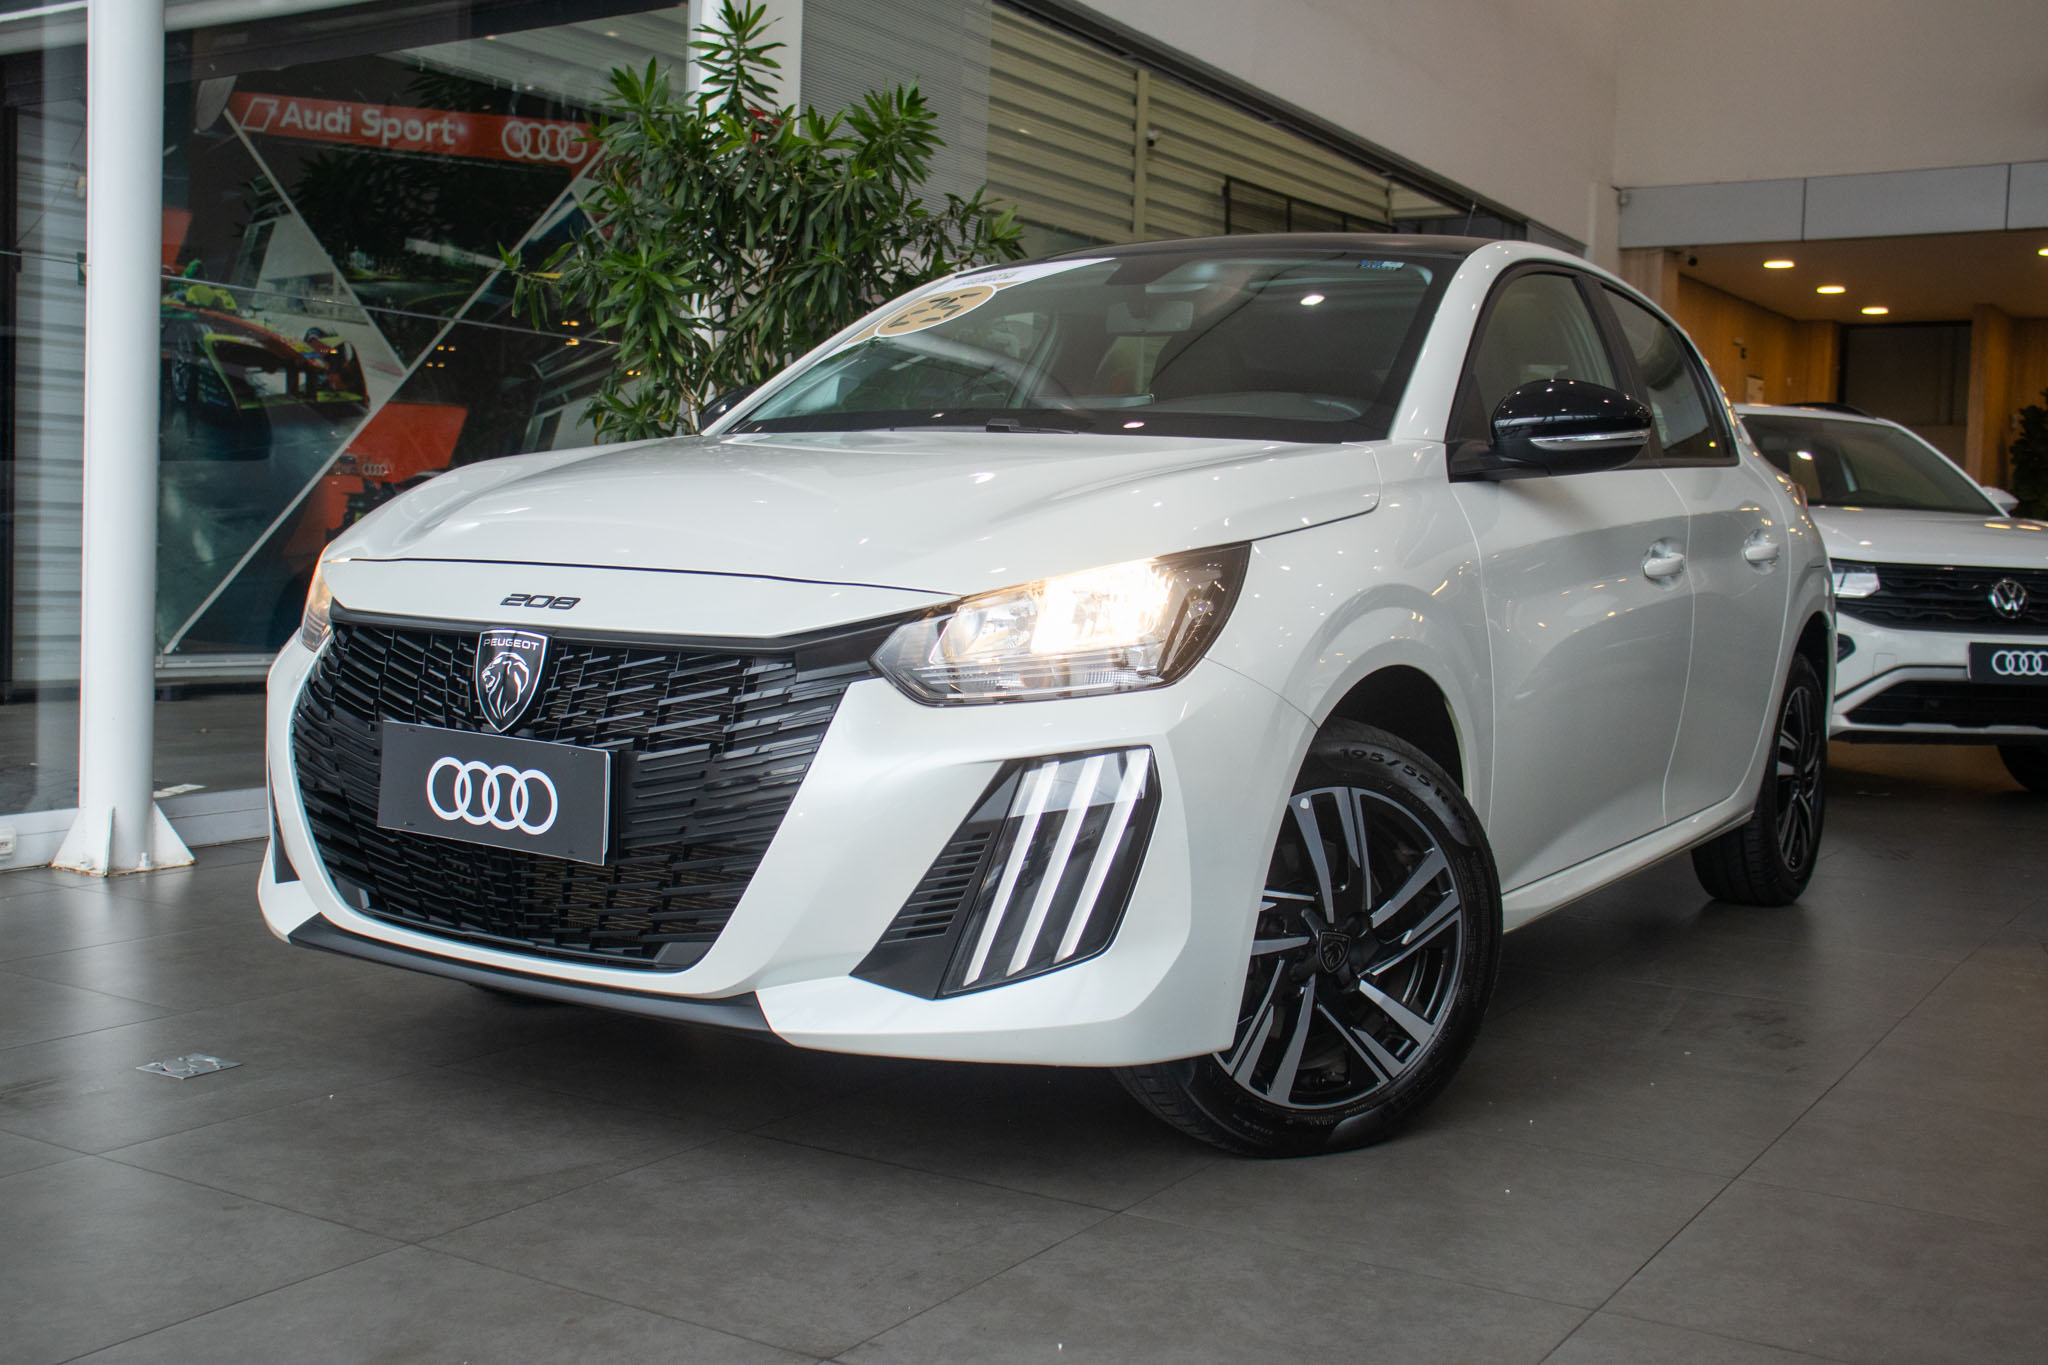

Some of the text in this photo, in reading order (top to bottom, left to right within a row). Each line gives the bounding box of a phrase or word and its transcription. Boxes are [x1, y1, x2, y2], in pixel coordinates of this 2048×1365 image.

[280, 101, 456, 147] Audi Sport
[500, 593, 581, 610] 208
[483, 638, 540, 651] PEUGEOT
